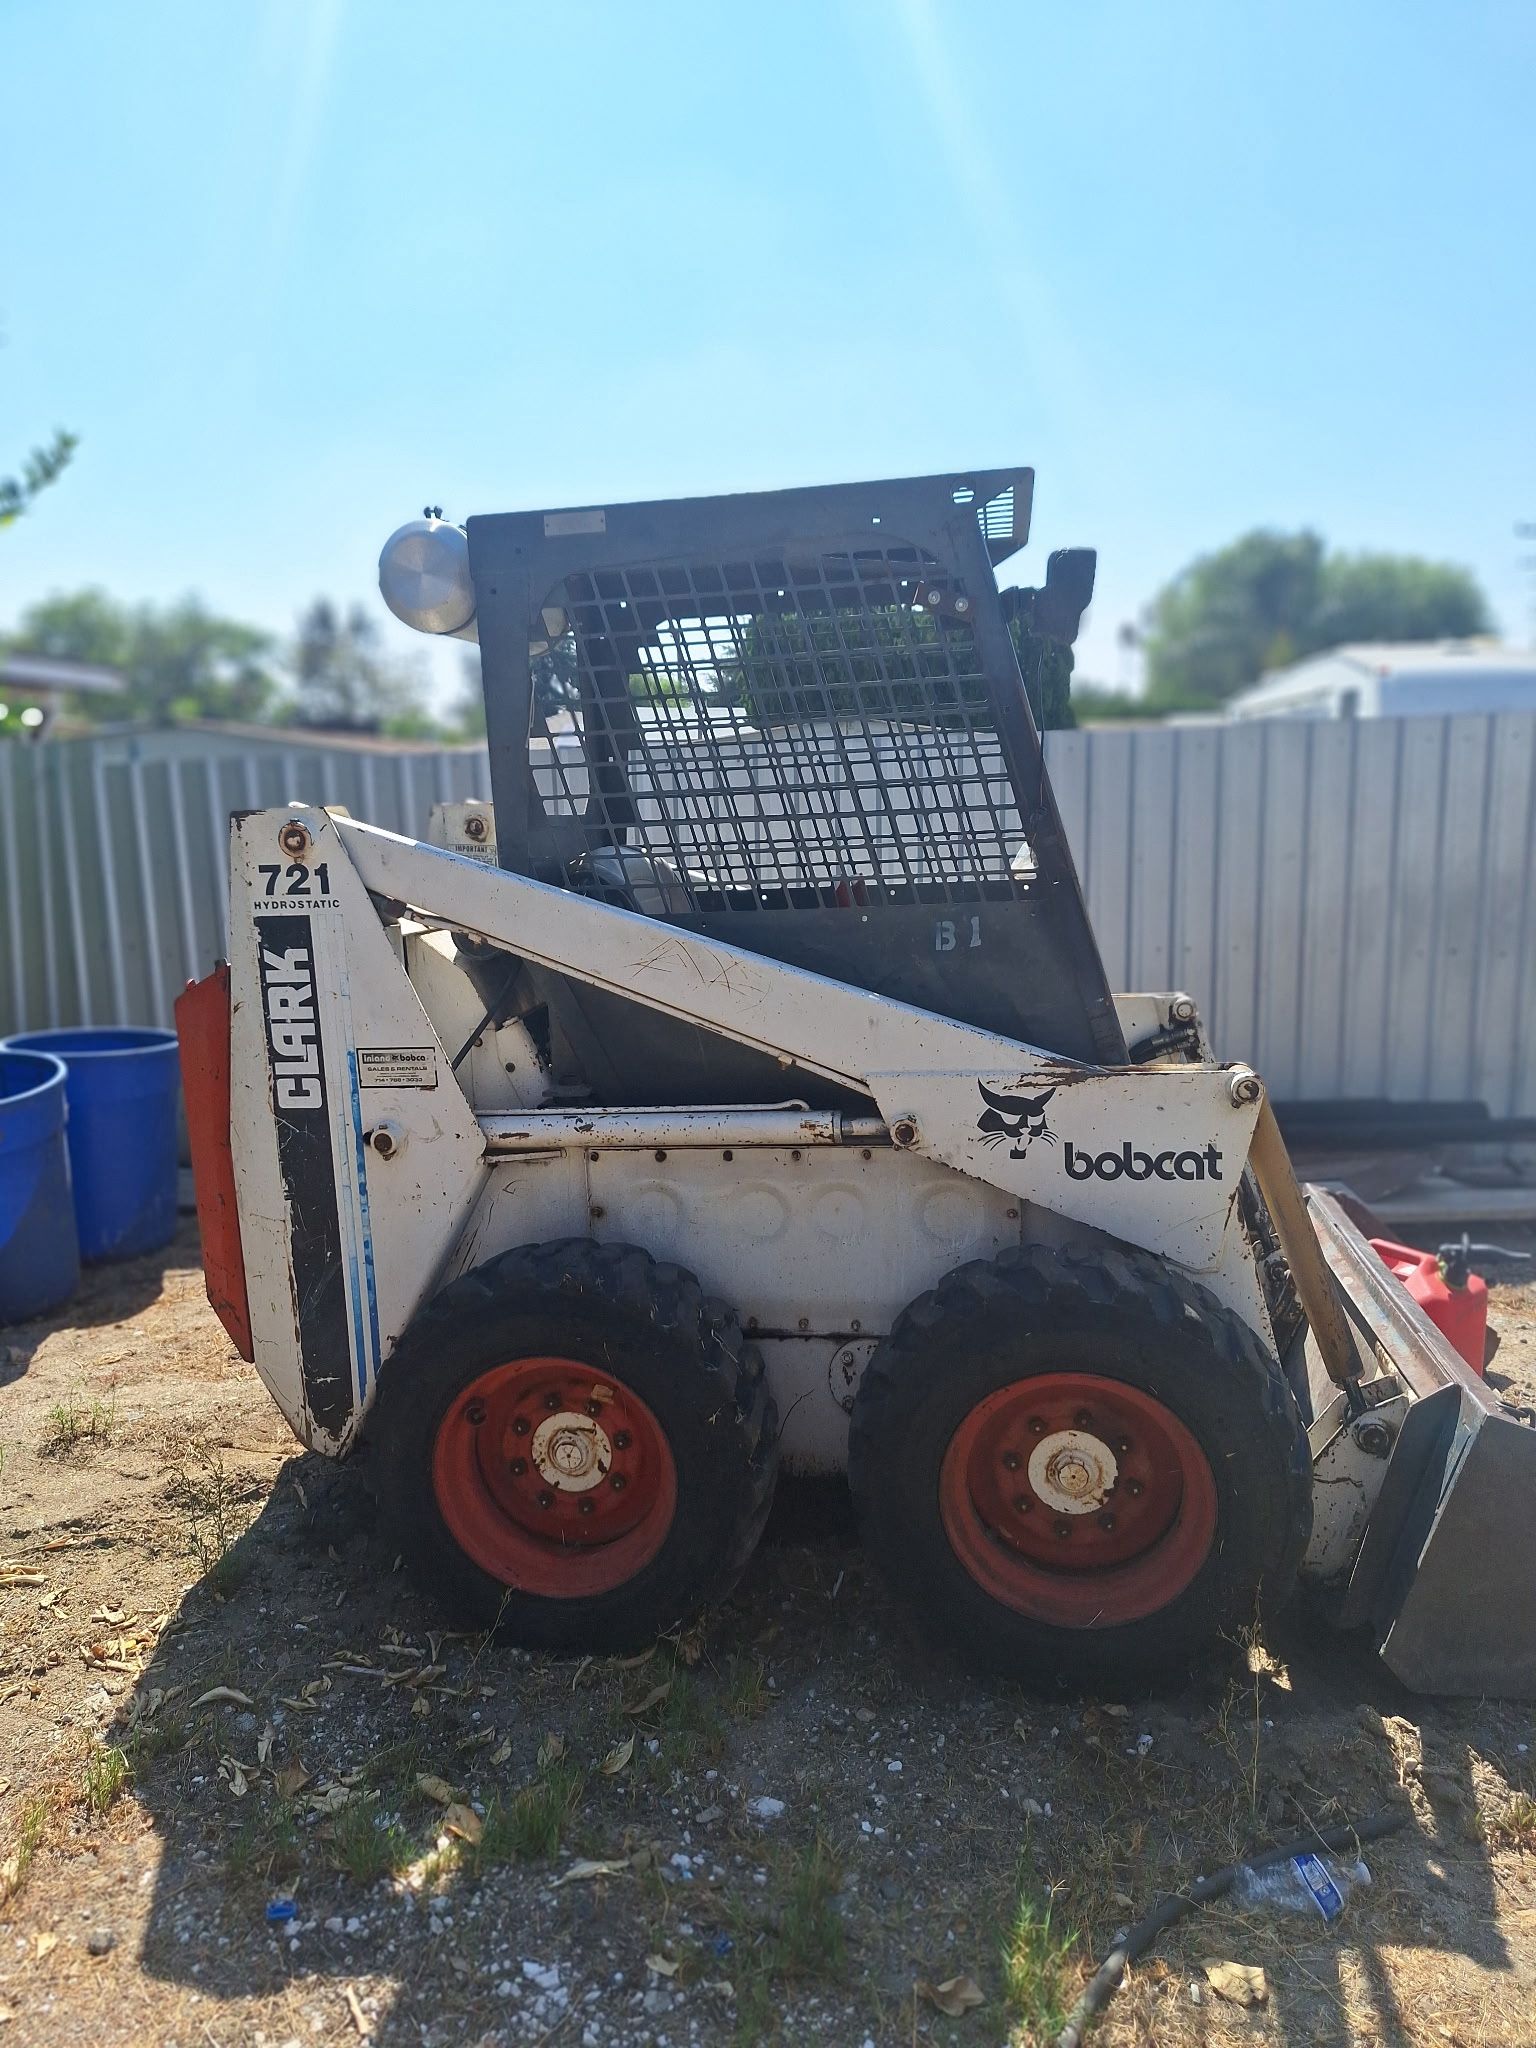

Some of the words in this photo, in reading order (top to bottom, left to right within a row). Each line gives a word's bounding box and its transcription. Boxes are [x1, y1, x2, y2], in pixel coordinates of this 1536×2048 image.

[258, 863, 330, 895] 721
[254, 900, 340, 909] HYDROSTATIC
[263, 948, 323, 1109] CLARK
[364, 1054, 391, 1063] inland
[1064, 1142, 1223, 1181] bobcat
